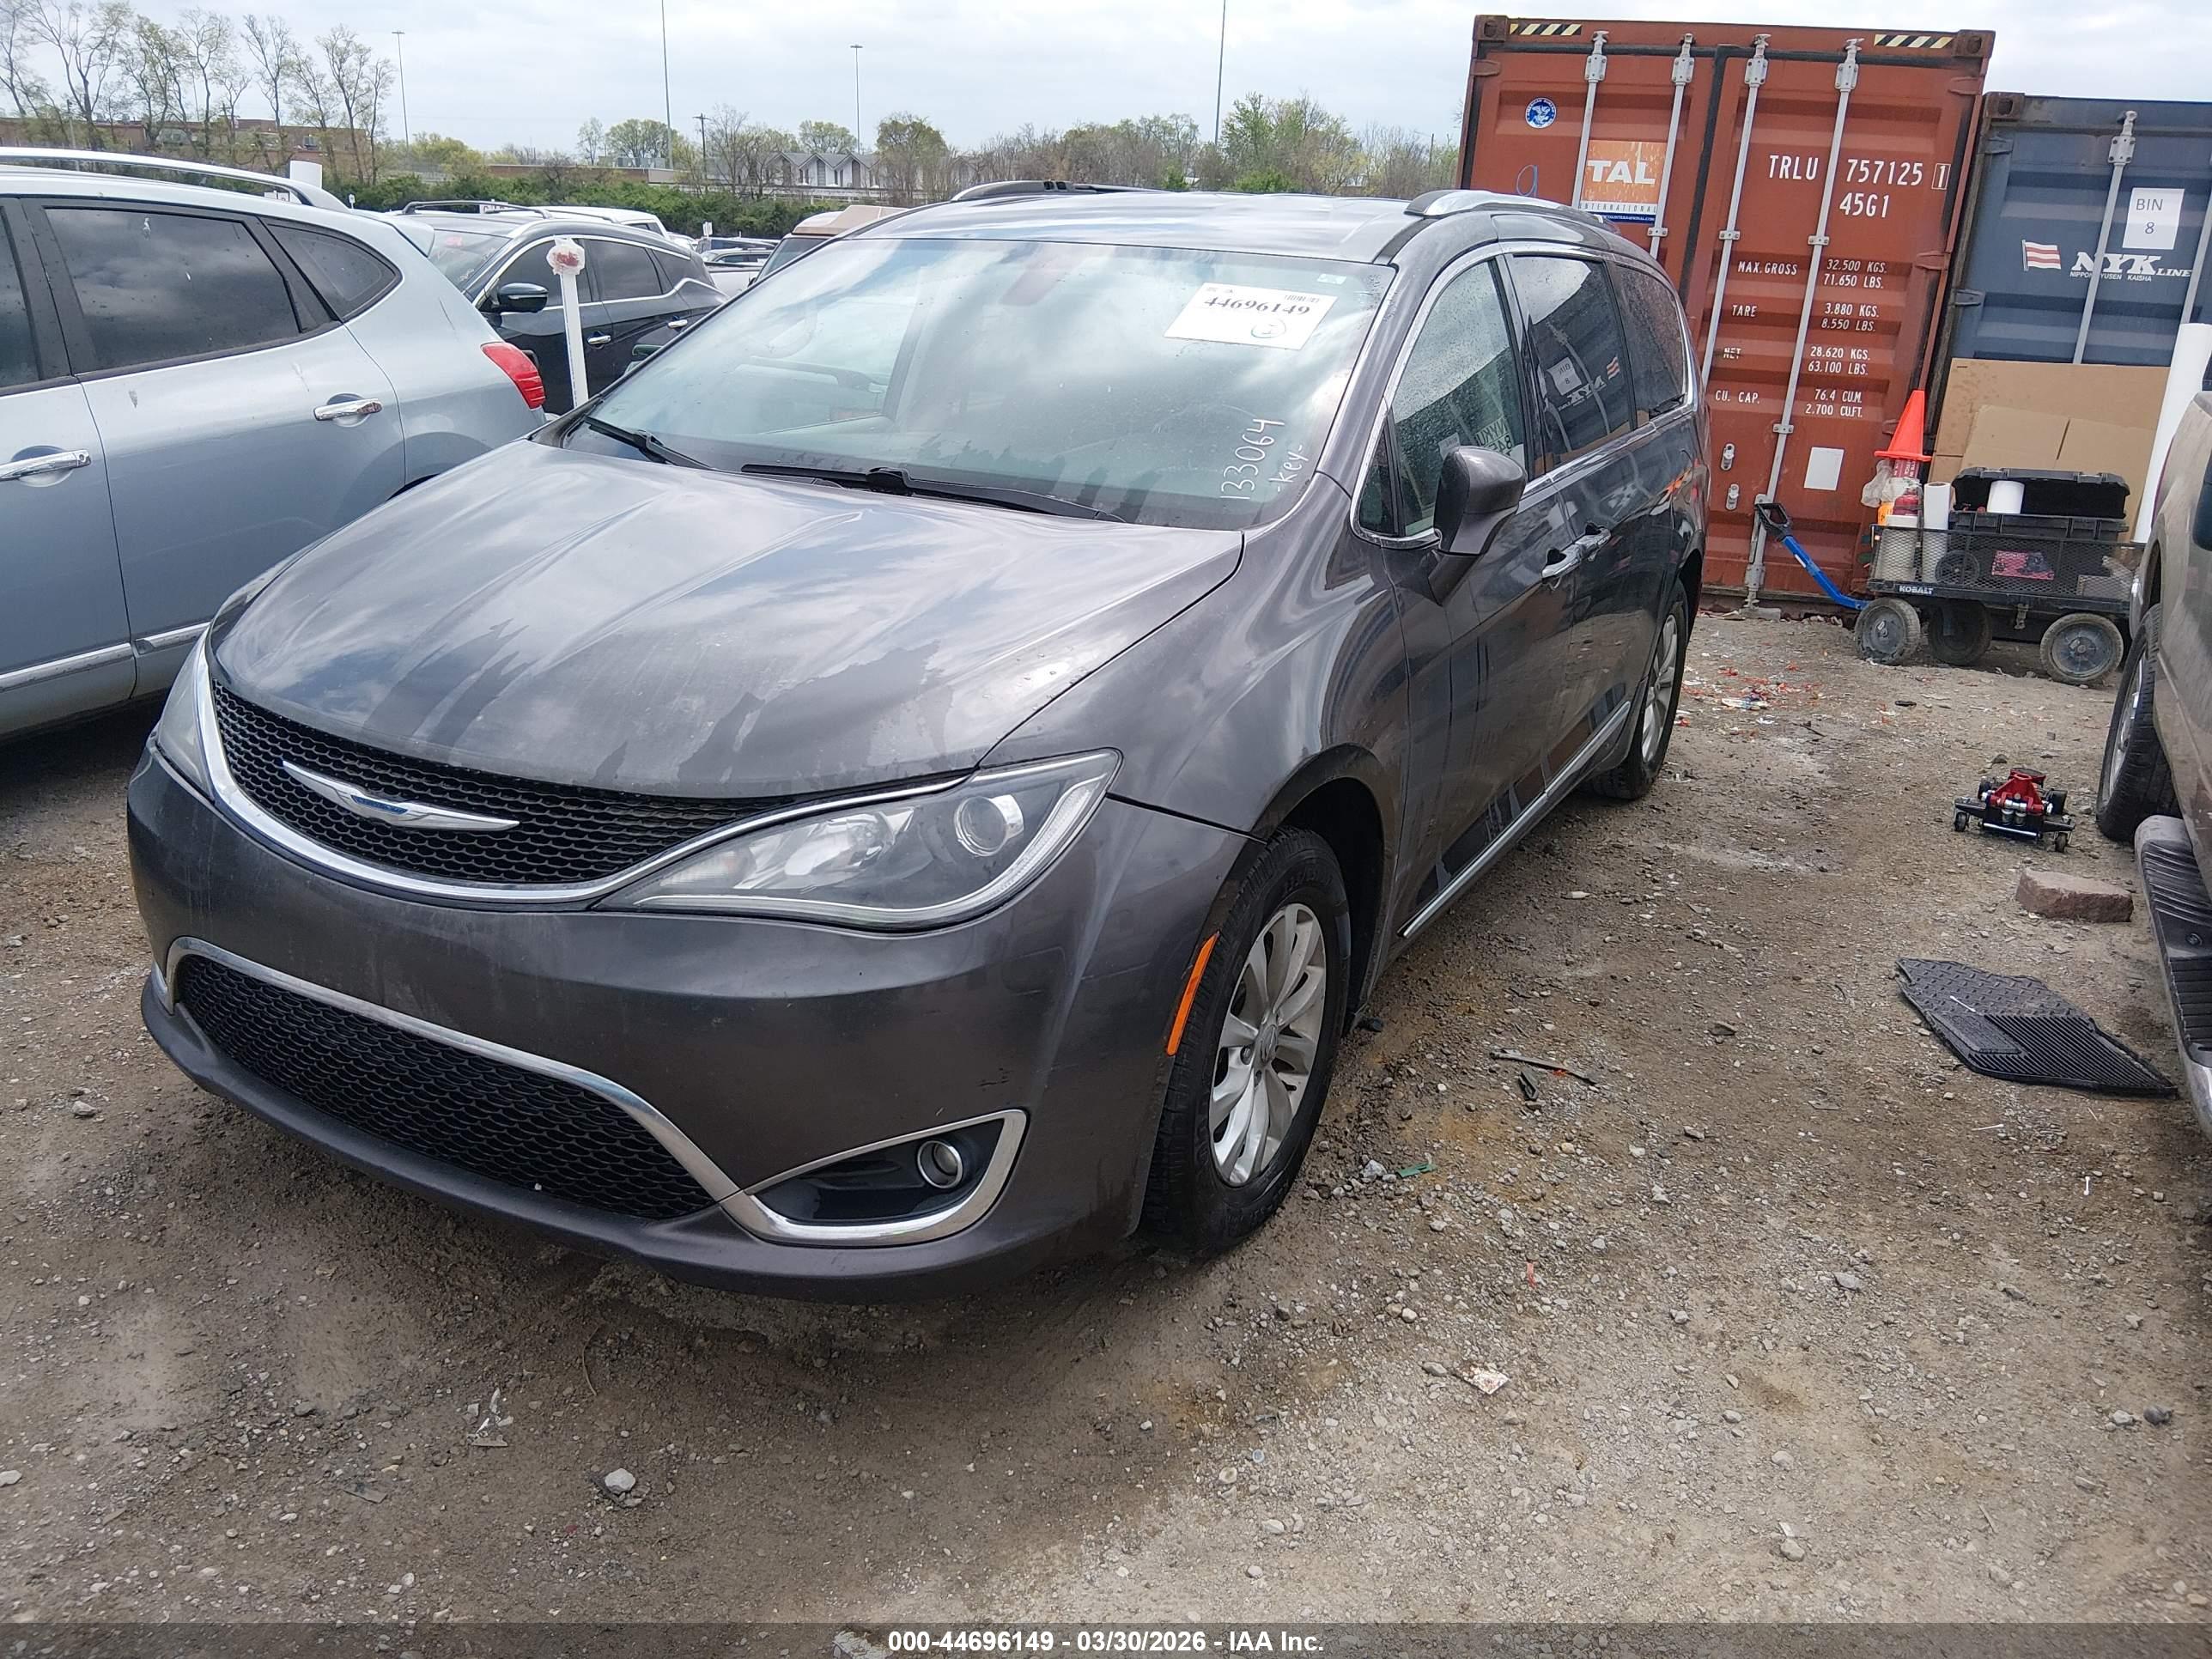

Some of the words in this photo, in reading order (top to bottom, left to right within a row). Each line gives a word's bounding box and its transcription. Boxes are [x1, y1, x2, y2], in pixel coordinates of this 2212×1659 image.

[1587, 160, 1656, 185] TAL
[1769, 155, 1819, 180] TRLU
[1846, 159, 1923, 186] 757125
[1839, 192, 1890, 218] 45G1
[2136, 198, 2163, 211] BIN
[2144, 222, 2155, 234] 8
[1826, 259, 1861, 272] 32.500
[1866, 261, 1887, 274] KGS.
[2071, 252, 2161, 276] NYK
[2156, 268, 2191, 277] LINE
[1824, 273, 1857, 287] 71.650
[1863, 276, 1884, 289] LBS.
[2127, 274, 2152, 283] KAISHA
[1204, 296, 1310, 315] 44696149
[1732, 304, 1758, 318] TARE
[1824, 302, 1853, 316] 3.880
[1859, 305, 1880, 318] KGS.
[1821, 318, 1850, 331] 8.550
[1855, 319, 1876, 332] LBS.
[1723, 347, 1741, 360] NET
[1810, 346, 1844, 359] 28.620
[1850, 349, 1870, 361] KGS.
[1808, 361, 1842, 374] 63.100
[1848, 362, 1869, 375] LBS.
[1715, 389, 1731, 402] CU.
[1738, 392, 1760, 404] CAP.
[1814, 388, 1836, 401] 76.4
[1805, 404, 1834, 416] 2.700
[1219, 419, 1285, 500] 133064
[1899, 585, 1933, 595] KOBALT
